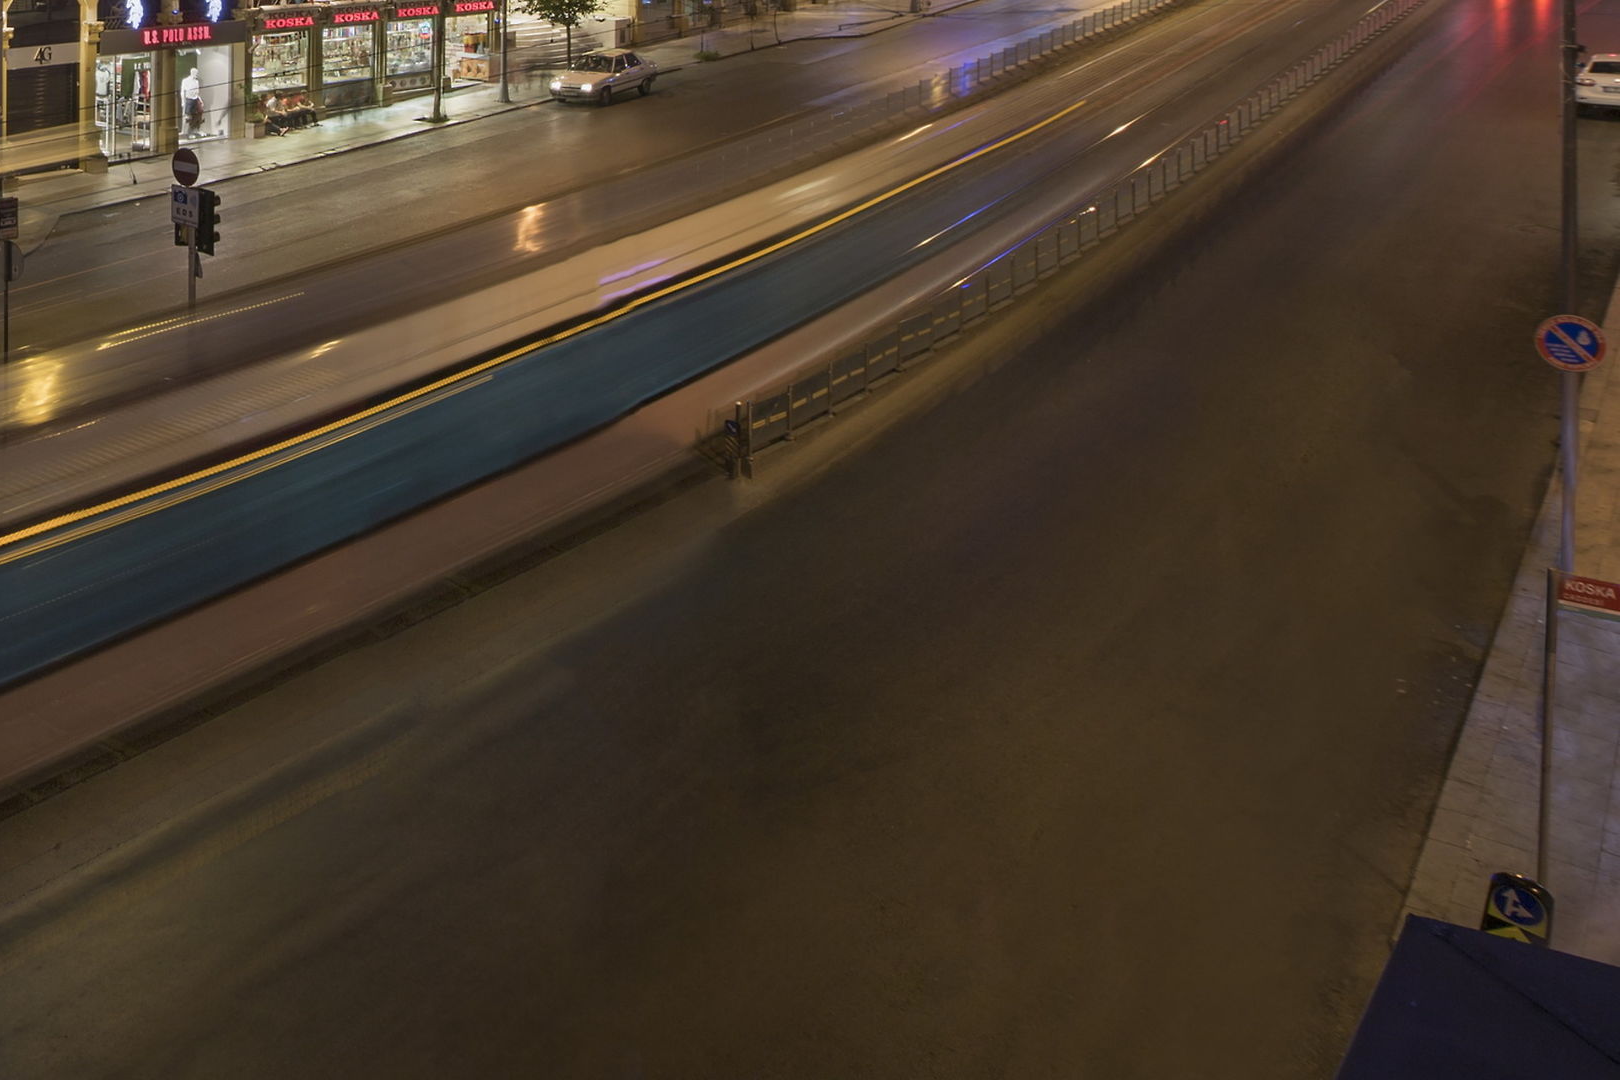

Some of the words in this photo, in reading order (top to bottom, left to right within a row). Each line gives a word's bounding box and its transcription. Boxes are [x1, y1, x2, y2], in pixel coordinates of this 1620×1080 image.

[397, 5, 439, 17] KOSKA
[455, 1, 494, 12] KOSKA
[265, 16, 314, 29] KOSKA
[334, 11, 379, 23] KOSKA
[143, 30, 160, 45] U.S.
[163, 28, 184, 42] POLO
[187, 26, 211, 41] ASSN.
[1564, 581, 1617, 600] KOSKA
